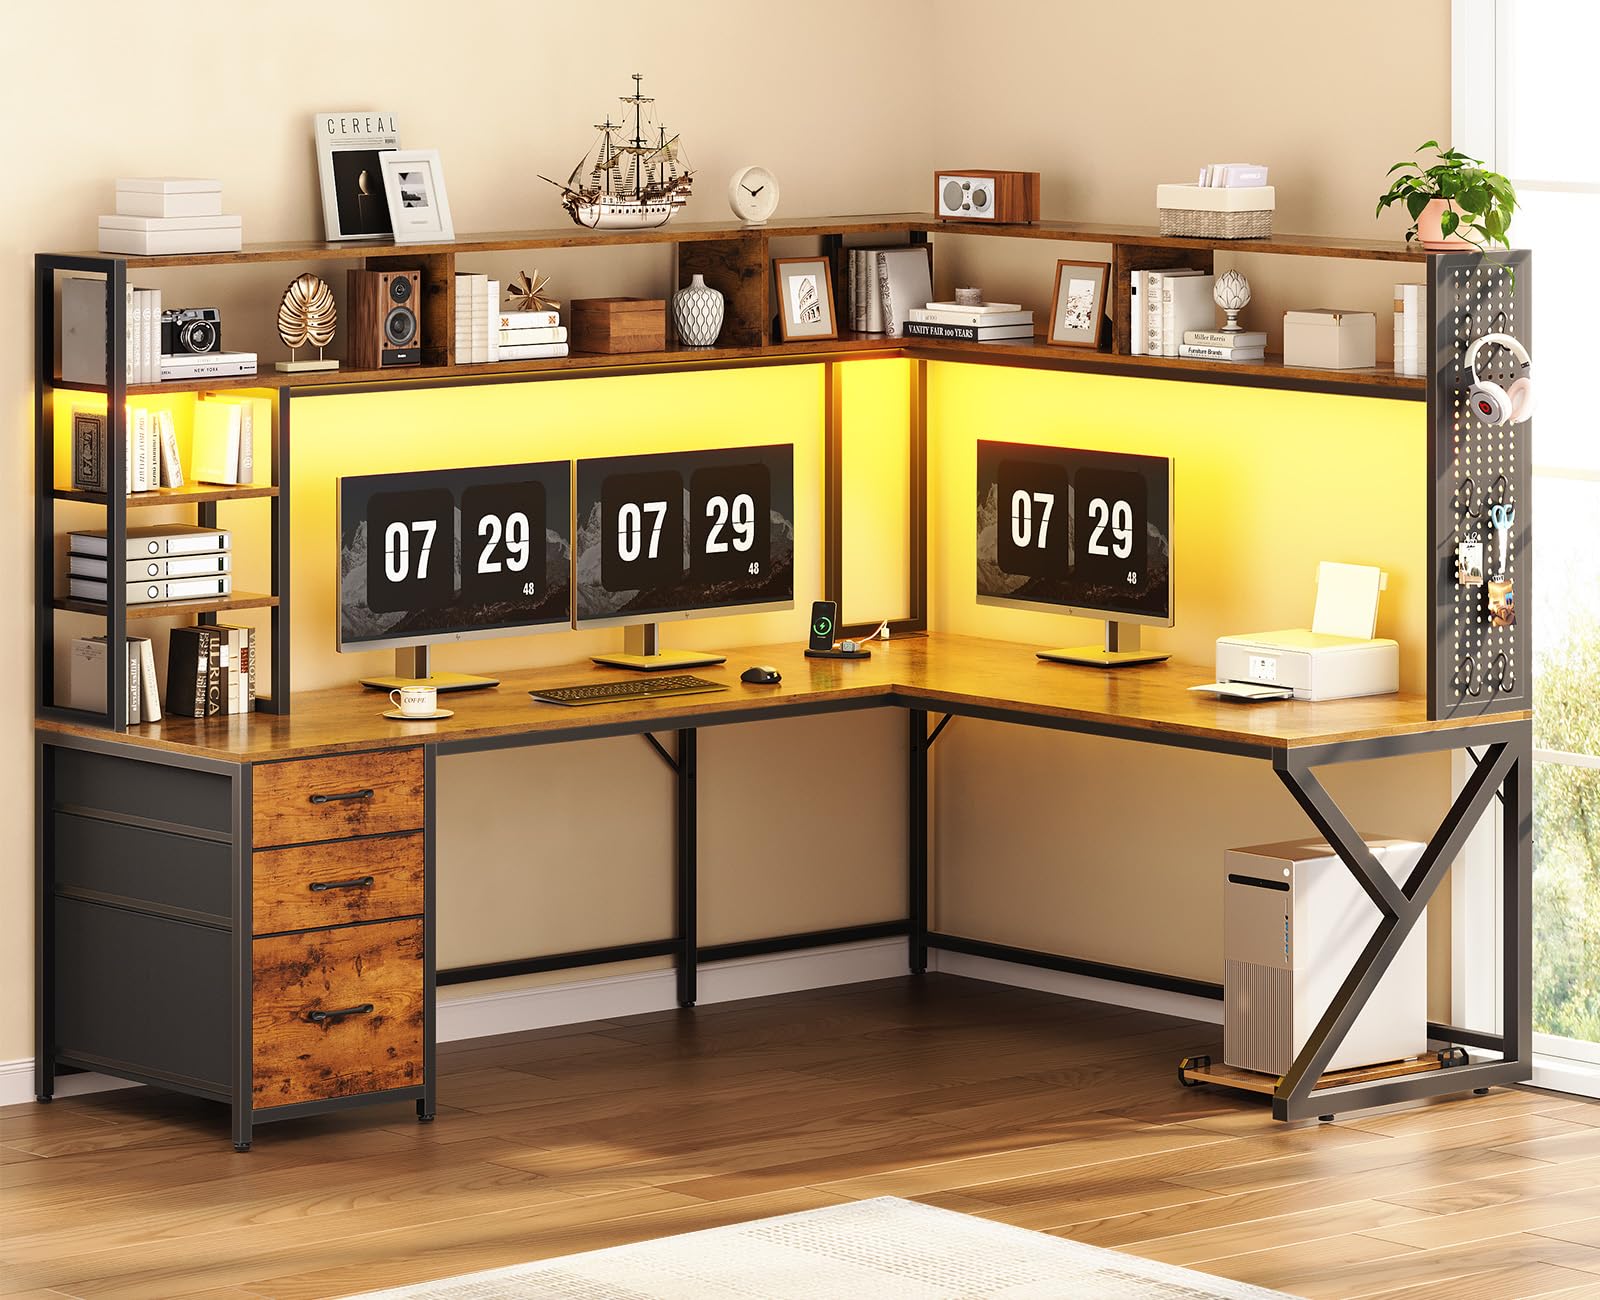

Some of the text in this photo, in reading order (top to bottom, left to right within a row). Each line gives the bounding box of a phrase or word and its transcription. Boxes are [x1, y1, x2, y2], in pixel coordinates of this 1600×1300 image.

[327, 117, 397, 135] CEREAL
[908, 324, 973, 338] VANITY FAIR 100 YEARS
[1194, 333, 1209, 341] Miller
[1188, 346, 1223, 356] Furniture Brands
[617, 492, 755, 562] 07 29
[1011, 490, 1133, 559] 07 29
[384, 511, 531, 583] 07 29
[748, 561, 760, 576] 48
[1126, 571, 1137, 585] 48
[522, 580, 535, 596] 48
